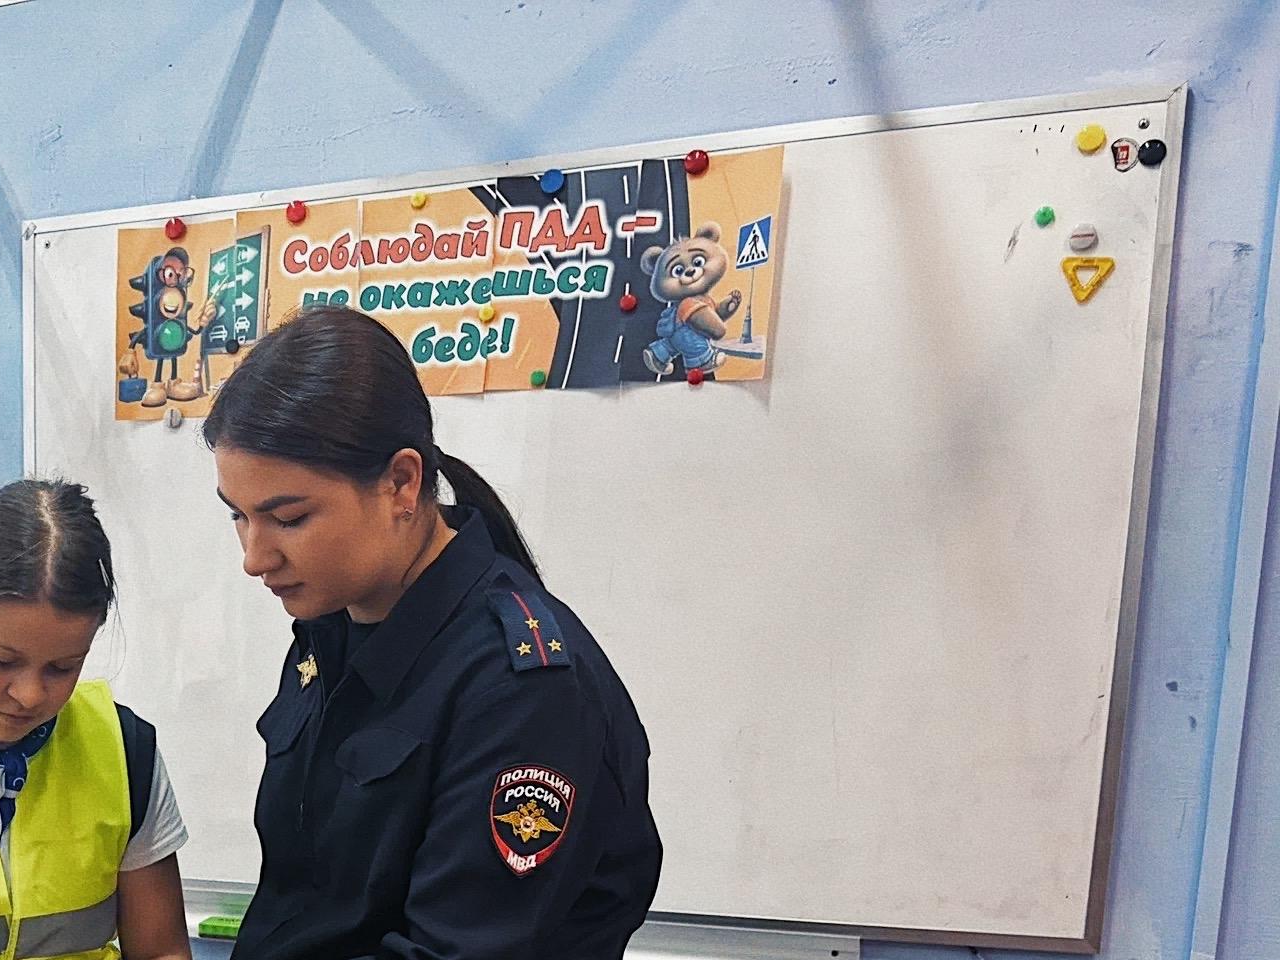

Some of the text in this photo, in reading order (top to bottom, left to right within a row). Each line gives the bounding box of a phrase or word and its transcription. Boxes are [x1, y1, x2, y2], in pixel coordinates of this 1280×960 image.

[283, 219, 489, 274] Соблюдай
[500, 206, 607, 252] ПДД
[360, 265, 608, 311] окажешься
[412, 318, 515, 363] беде!
[500, 769, 571, 799] ПОЛИЦИЯ
[504, 785, 560, 812] РОССИЯ
[507, 850, 537, 872] МВД
